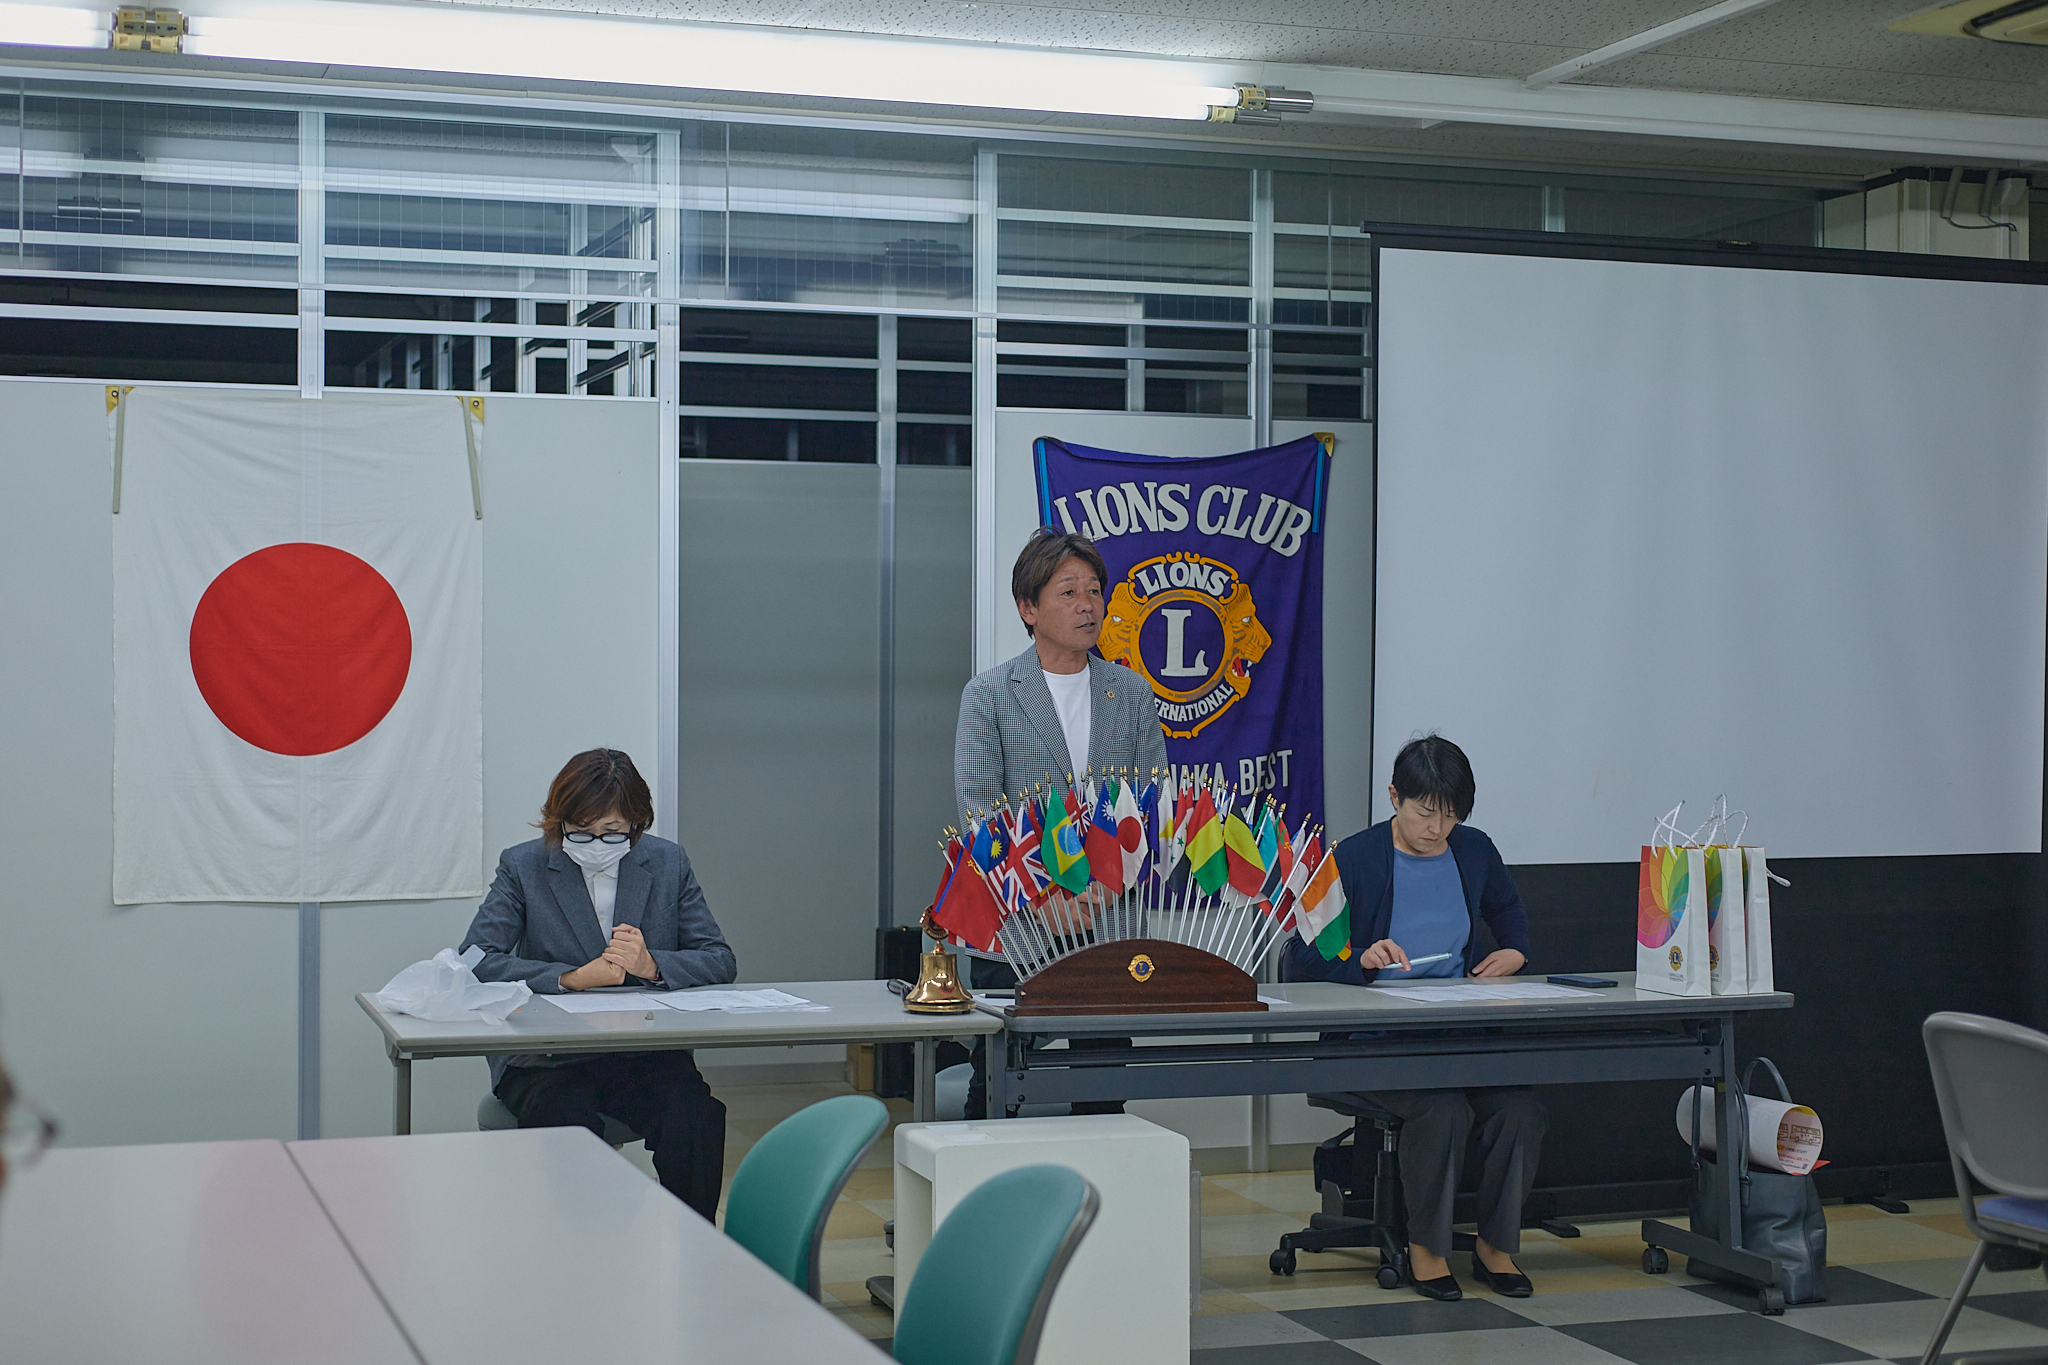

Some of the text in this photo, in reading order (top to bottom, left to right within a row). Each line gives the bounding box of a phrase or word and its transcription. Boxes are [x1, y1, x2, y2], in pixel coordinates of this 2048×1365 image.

[1053, 481, 1312, 557] LIONS CLUB
[1135, 561, 1230, 596] LIONS
[1160, 608, 1209, 677] L
[1239, 749, 1293, 796] BEST
